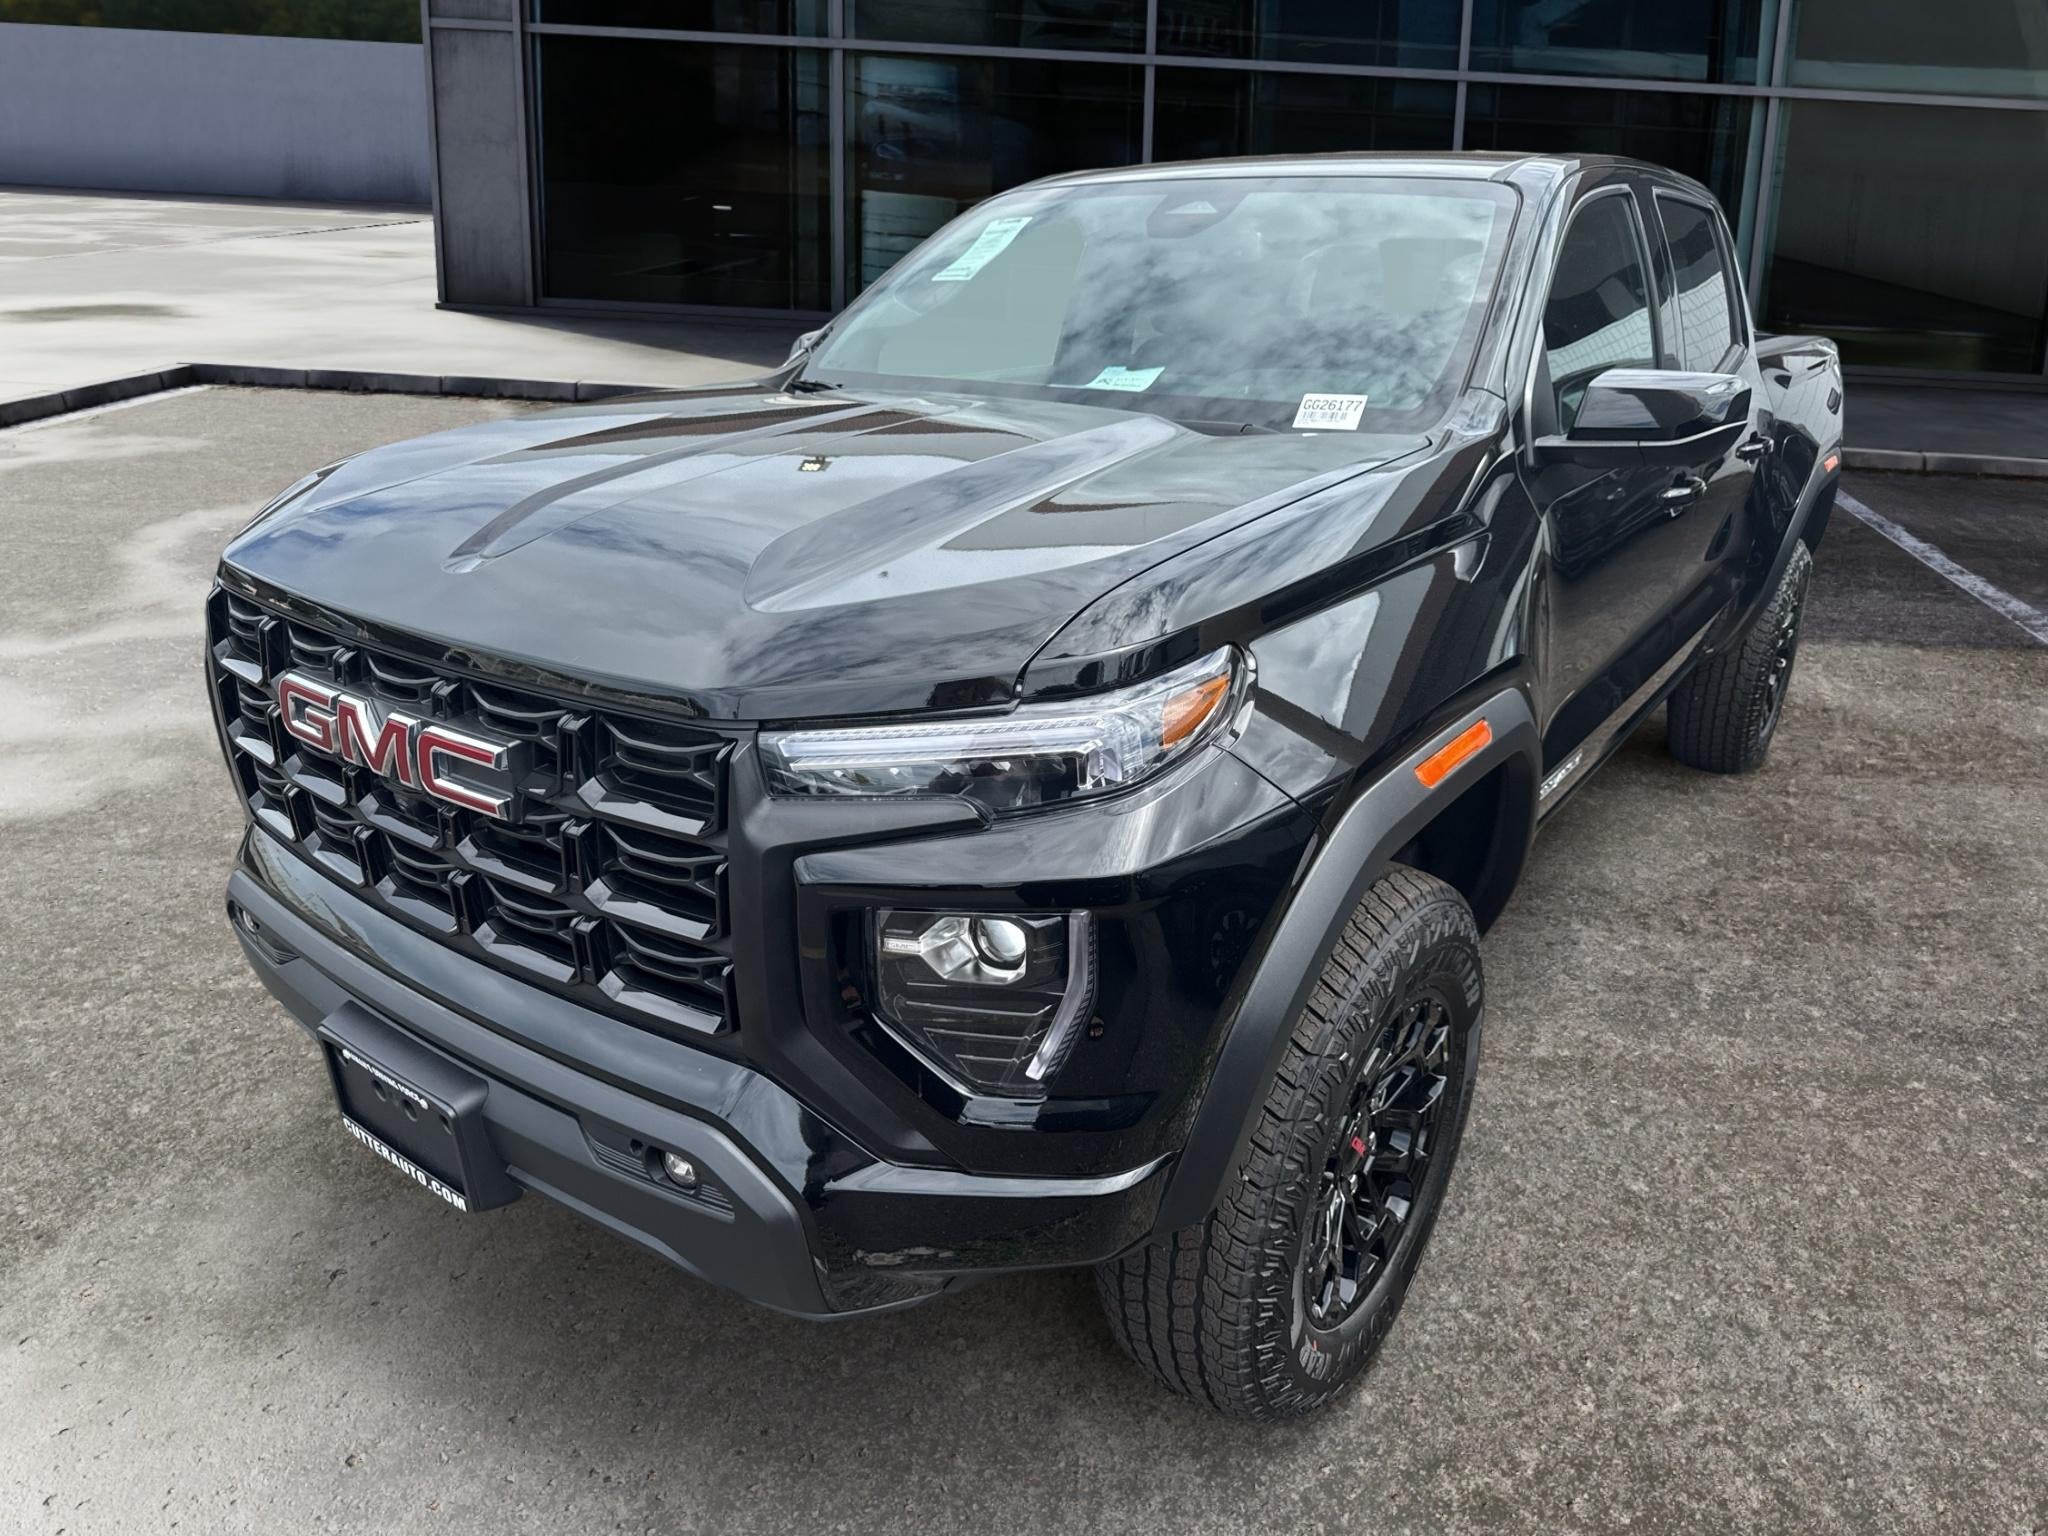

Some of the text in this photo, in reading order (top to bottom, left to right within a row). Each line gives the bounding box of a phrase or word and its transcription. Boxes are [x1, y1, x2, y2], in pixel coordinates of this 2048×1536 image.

[1303, 399, 1363, 411] GG26177
[279, 673, 512, 821] GMC
[342, 1117, 467, 1212] CUTTERAUTO.COM
